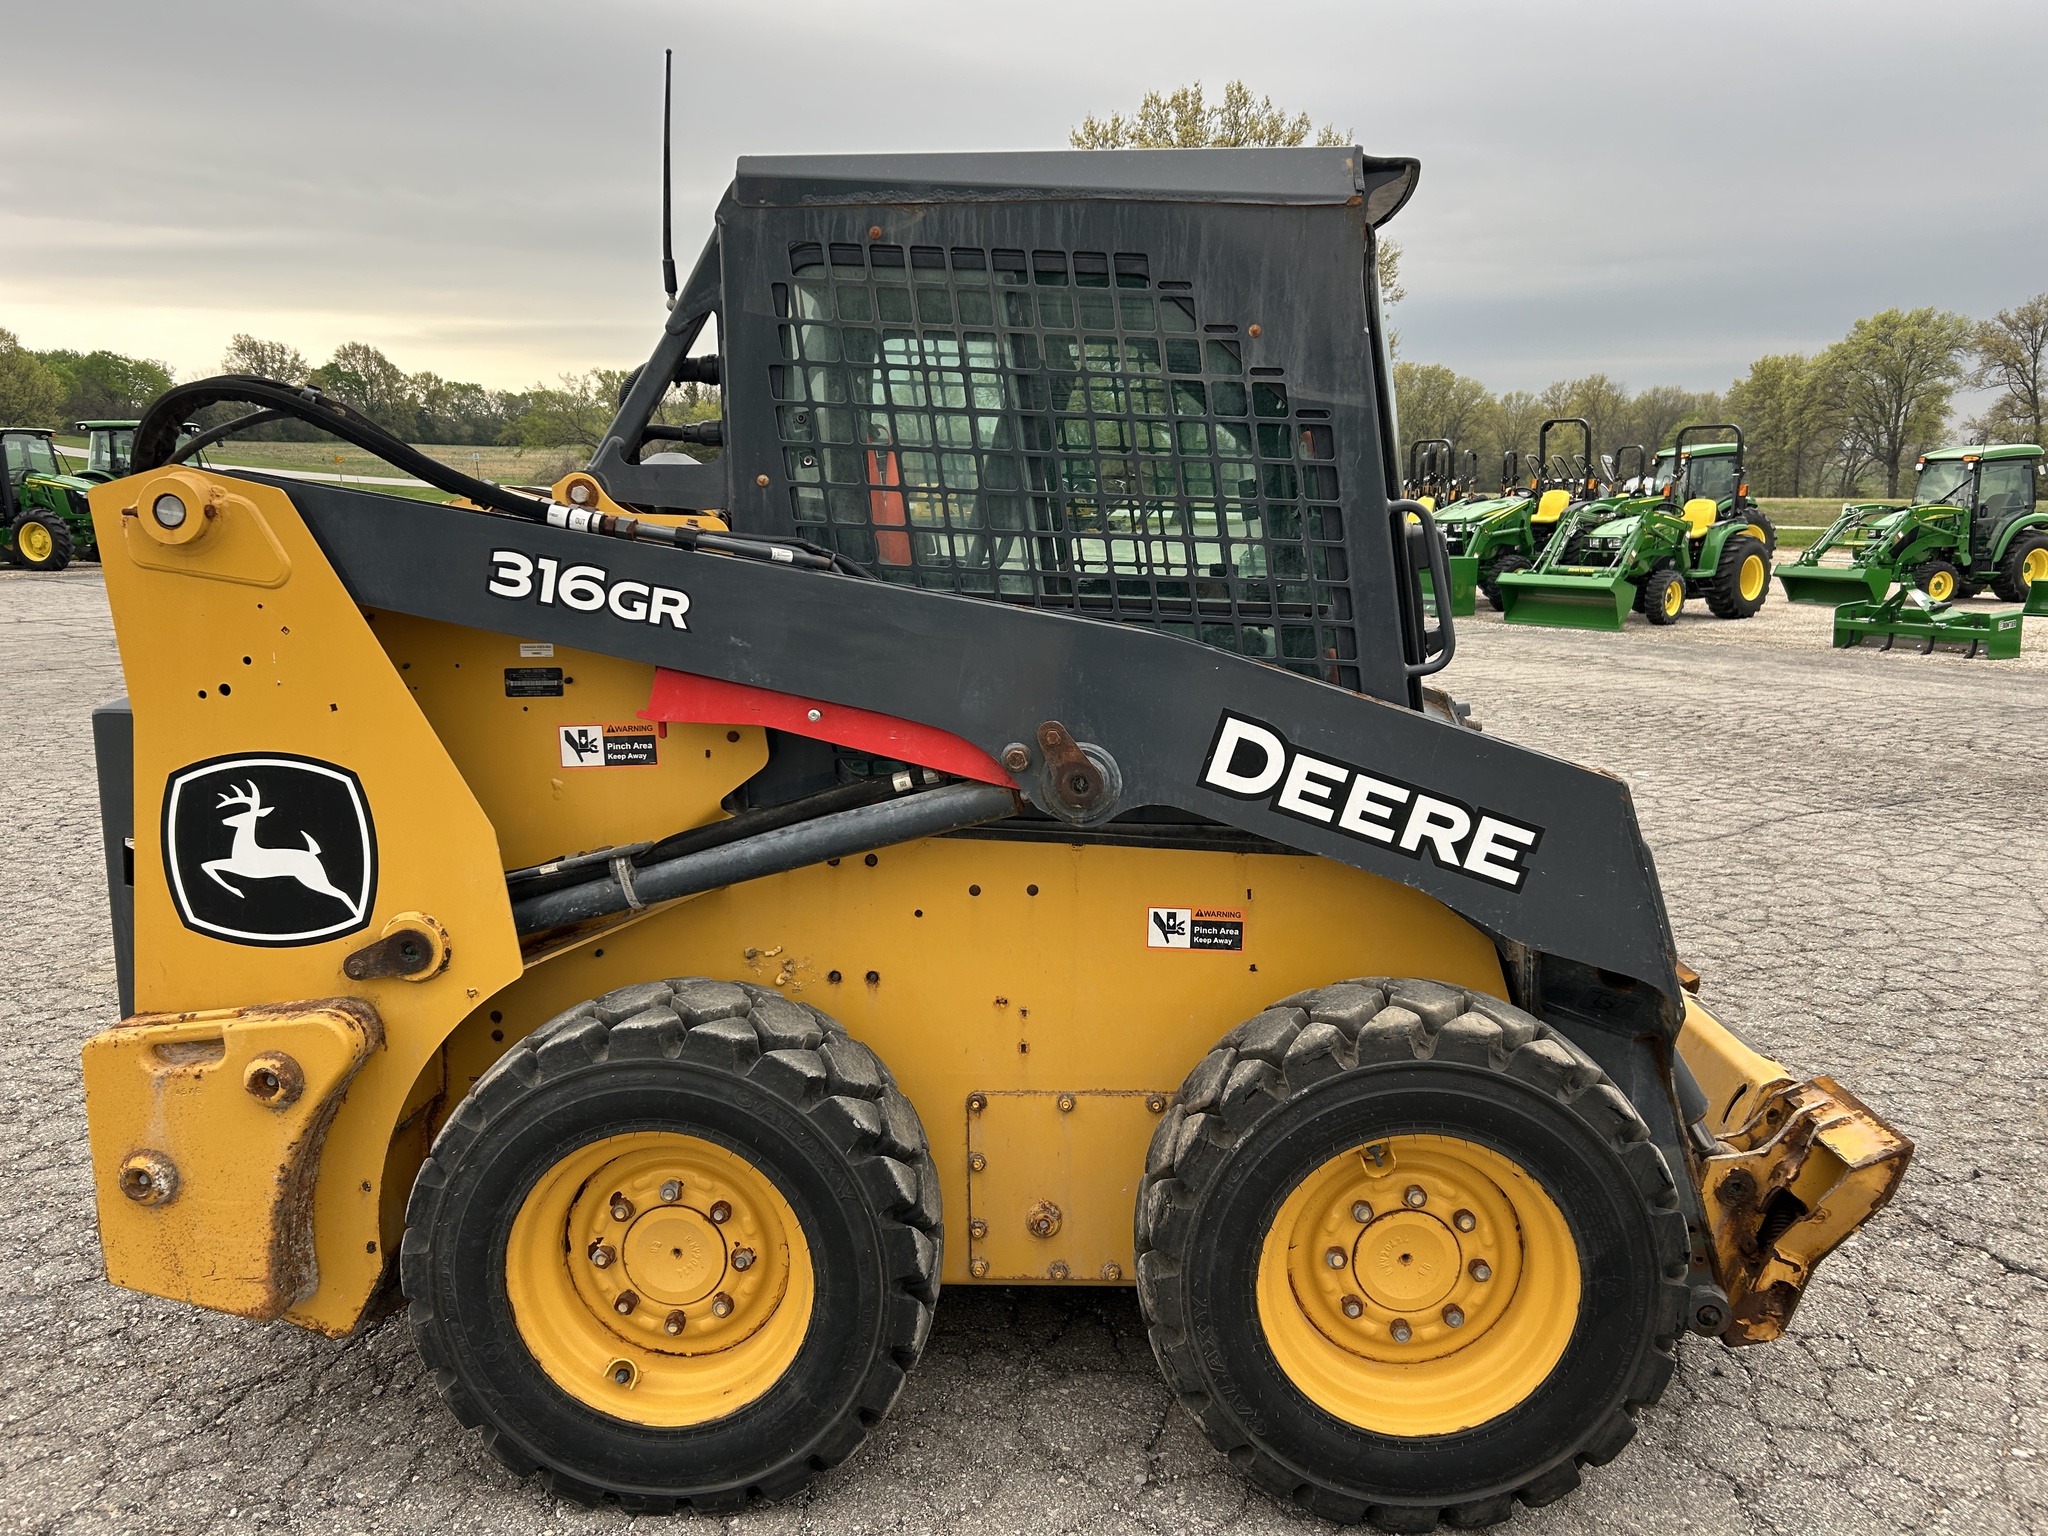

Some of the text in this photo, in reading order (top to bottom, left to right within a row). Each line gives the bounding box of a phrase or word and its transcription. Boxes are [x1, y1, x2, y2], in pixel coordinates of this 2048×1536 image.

[489, 550, 691, 630] 316GR
[614, 724, 653, 733] WARNING
[606, 742, 653, 750] Pinch Area
[607, 753, 648, 761] Keep Away
[1204, 716, 1537, 886] DEERE
[1203, 910, 1242, 919] WARNING
[1193, 926, 1240, 936] Pinch Area
[1193, 936, 1233, 946] Keep Away
